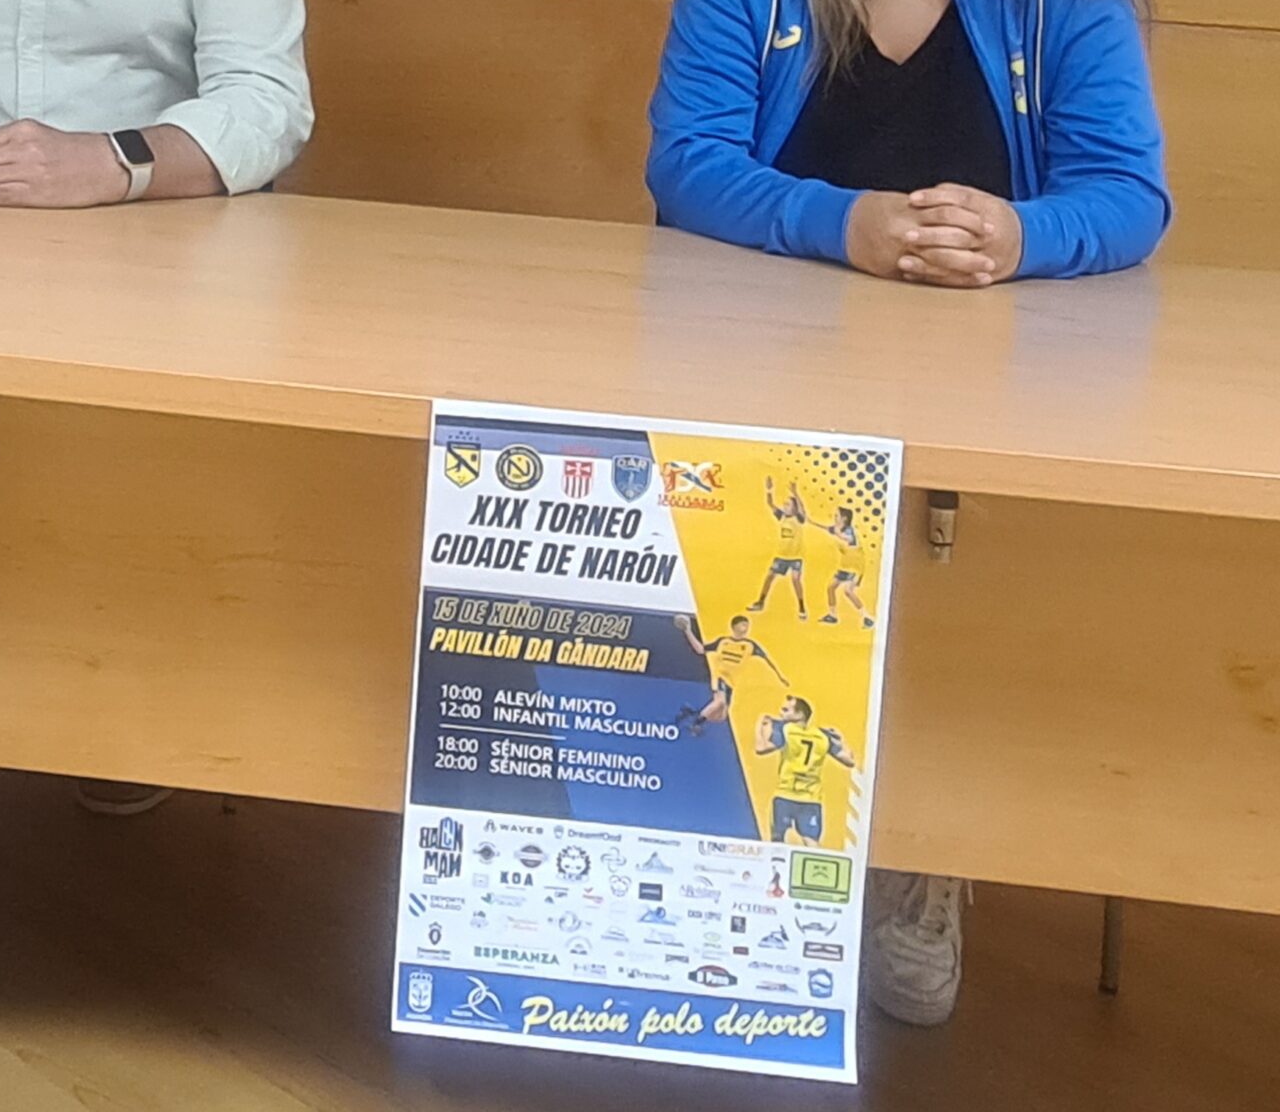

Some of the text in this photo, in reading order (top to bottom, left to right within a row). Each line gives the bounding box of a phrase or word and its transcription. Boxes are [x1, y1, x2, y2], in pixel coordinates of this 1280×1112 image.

[468, 494, 529, 530] XXX
[535, 501, 642, 539] TORNEO
[431, 533, 678, 587] CIDADE DE NARÓN
[433, 597, 632, 639] 15 DE XUÑO DE 2024
[429, 627, 650, 673] PAVILLÓN DA GÁNDARA
[440, 684, 616, 717] 10:00 ALEVÍN MIXTO
[439, 702, 679, 741] 12:00 INFANTIL MASCULINO
[434, 753, 478, 771] 20:00
[557, 766, 661, 791] MASCULINO
[437, 736, 646, 771] 18:00 SÉNIOR FEMININO
[801, 739, 814, 766] 7
[474, 946, 561, 965] ESPERANZA
[521, 996, 630, 1034] Paixón
[637, 1001, 704, 1044] polo
[714, 1002, 827, 1045] deporte
